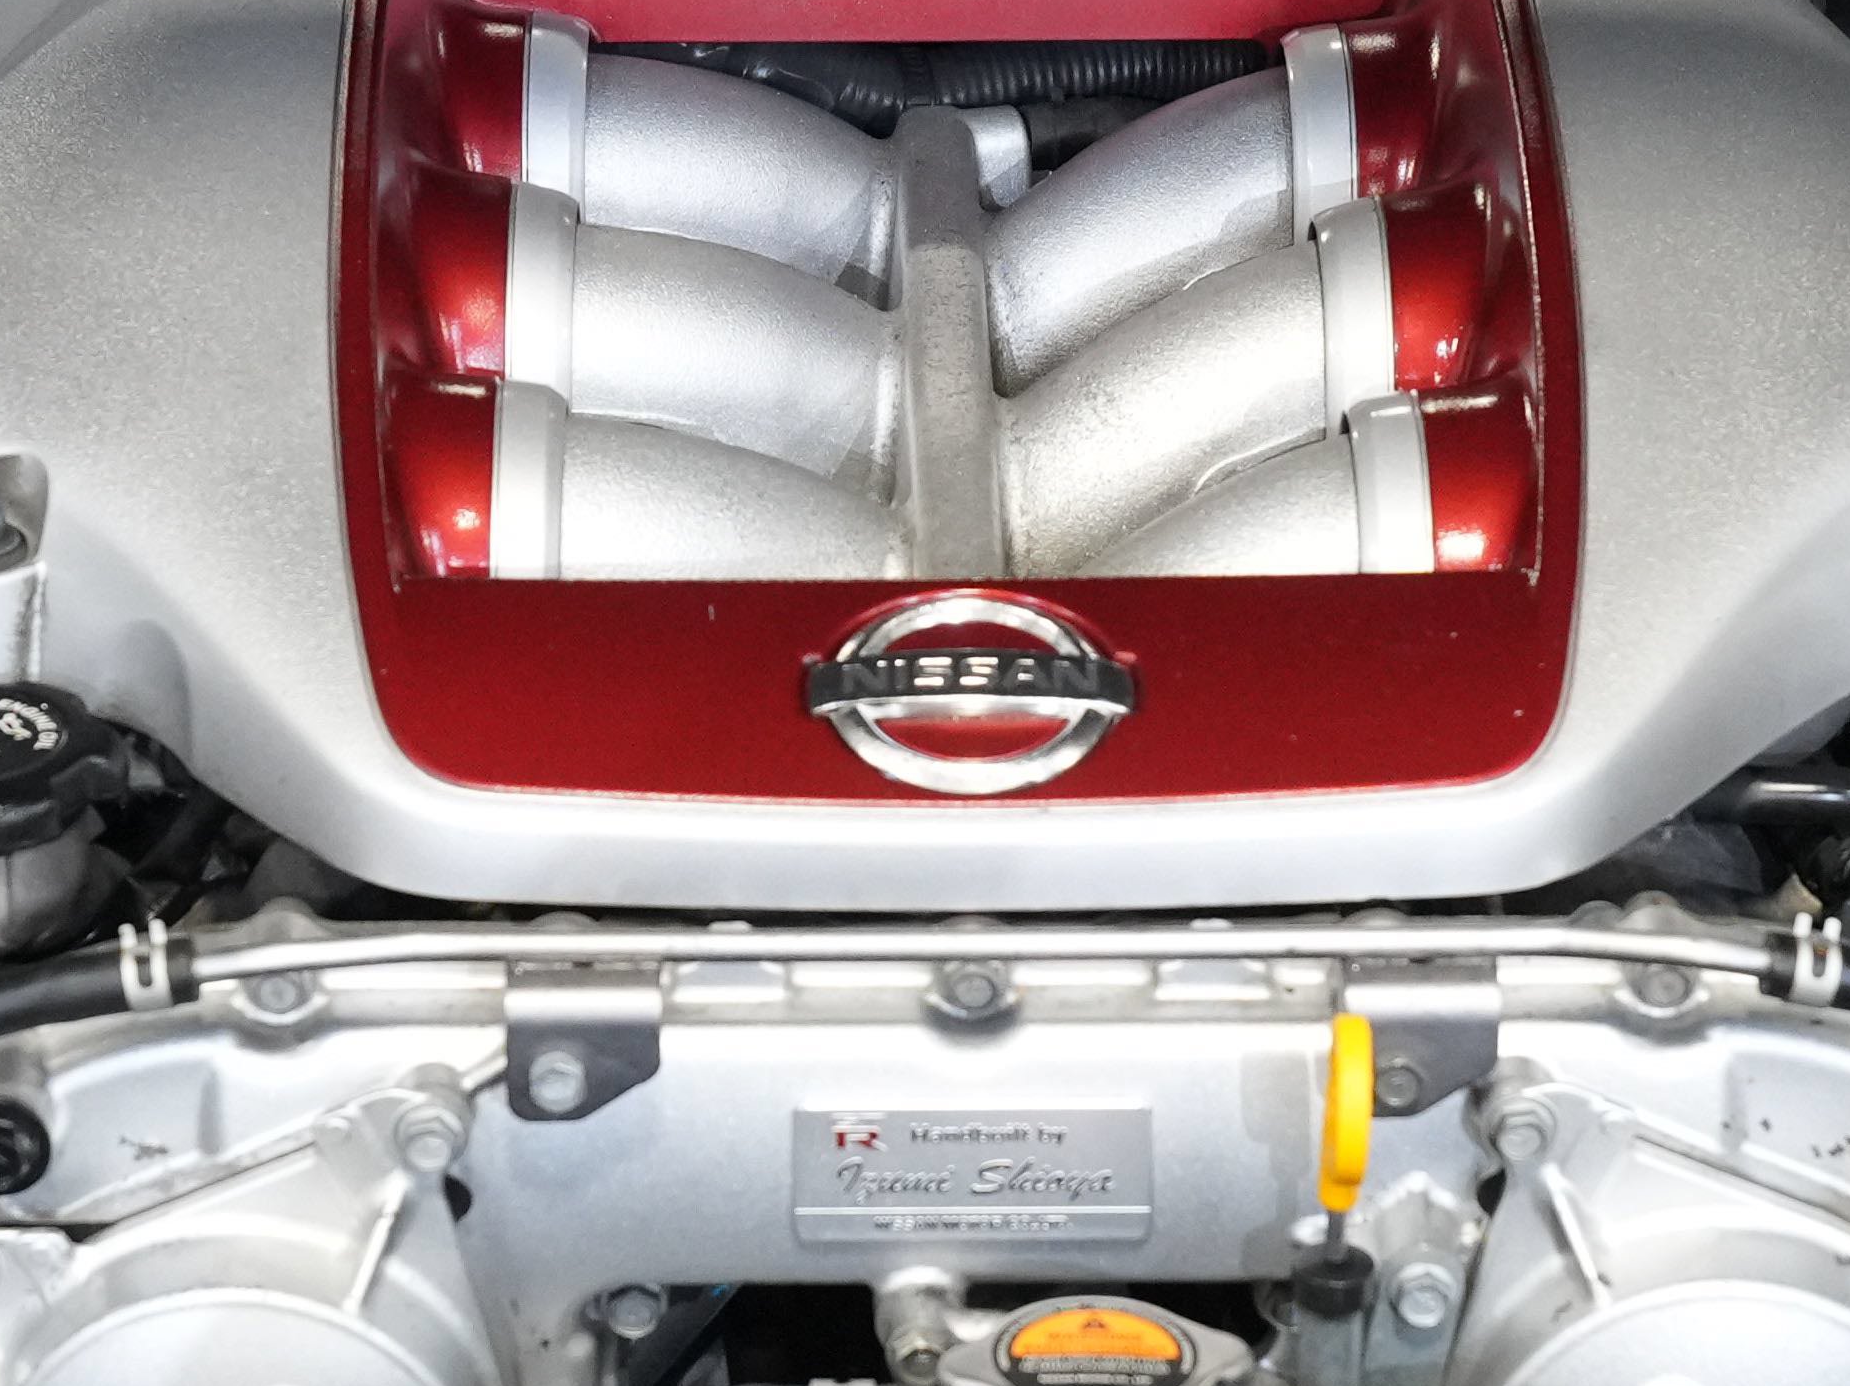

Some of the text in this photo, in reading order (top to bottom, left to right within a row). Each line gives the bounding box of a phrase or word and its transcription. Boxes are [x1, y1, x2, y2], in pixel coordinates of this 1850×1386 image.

[840, 655, 1100, 694] NISSAN
[909, 1121, 1069, 1147] Handbuilt by
